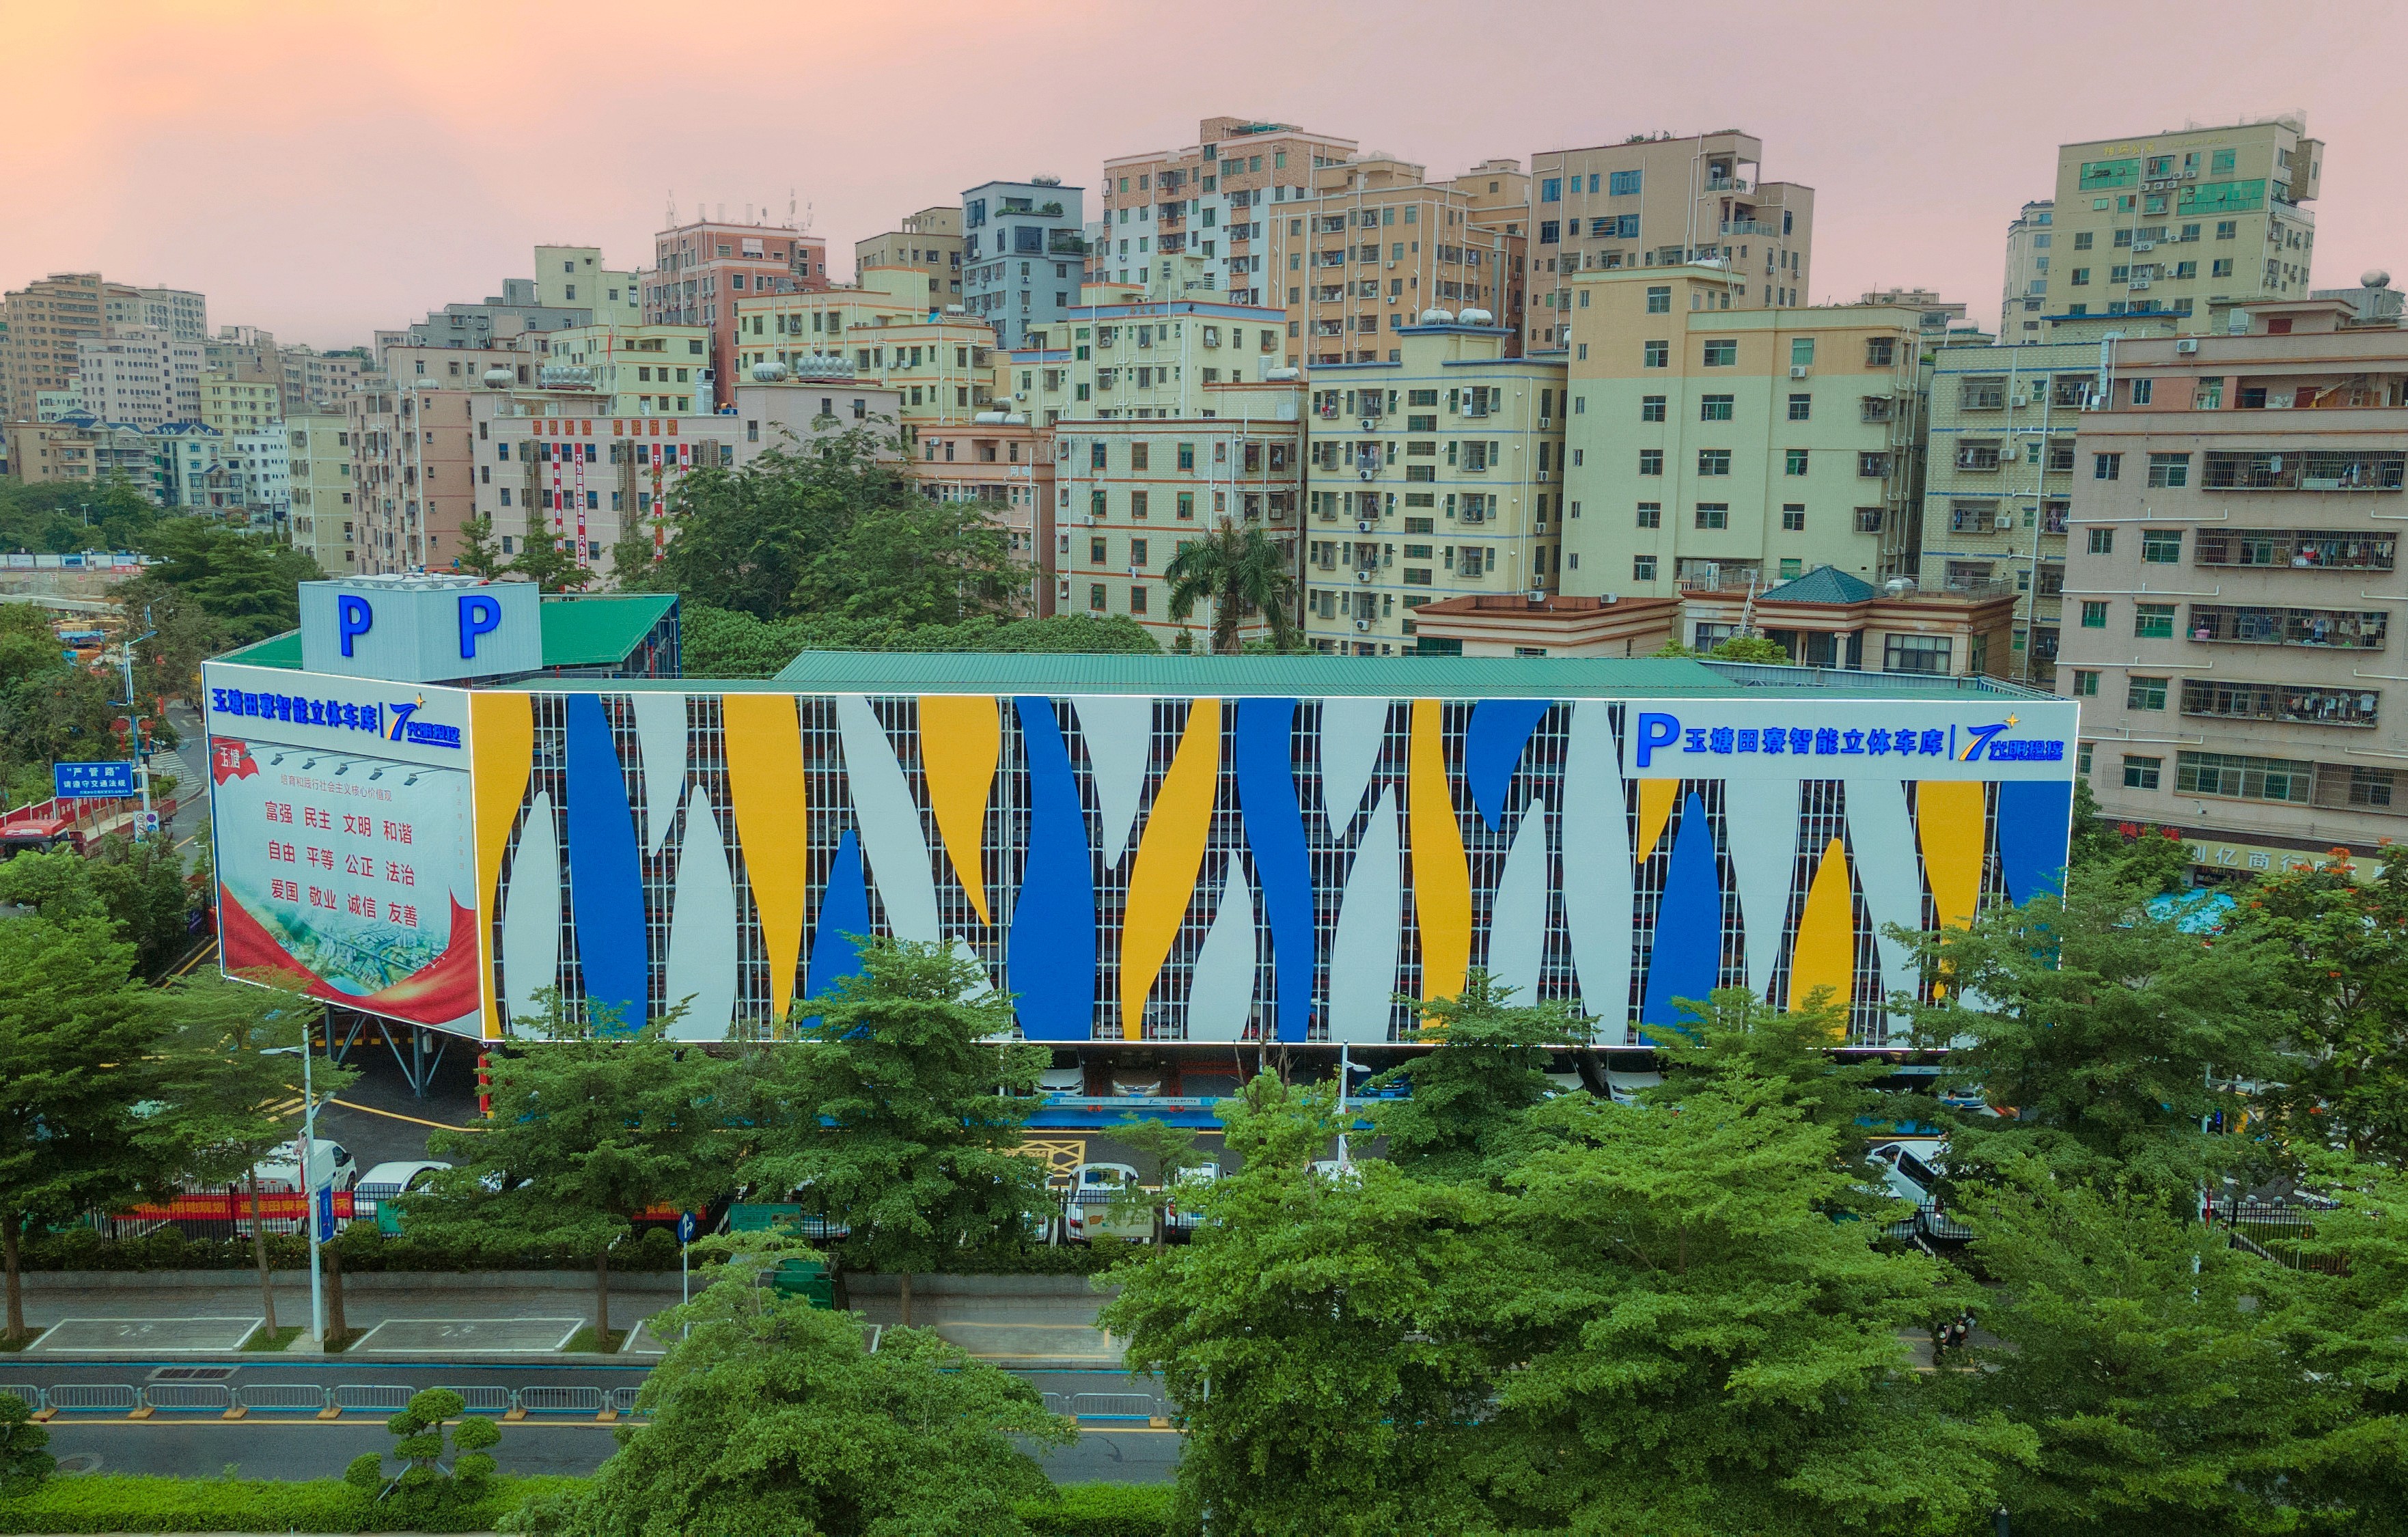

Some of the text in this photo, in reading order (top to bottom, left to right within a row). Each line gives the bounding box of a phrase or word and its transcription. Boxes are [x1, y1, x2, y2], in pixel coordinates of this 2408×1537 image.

[339, 595, 372, 657] P
[458, 596, 501, 658] P
[212, 689, 376, 732] 玉塘田寮智能立体车库
[1637, 712, 1680, 767] P
[1683, 726, 1944, 756] 玉塘田寮智能立体车库
[281, 774, 391, 801] 培育和践行社会主义核心价值观
[265, 801, 411, 845] 富强 民主 文明 和谐
[268, 840, 414, 887] 自由 平等 公正 法治
[271, 878, 417, 928] 爱国 敬业 诚信 友善
